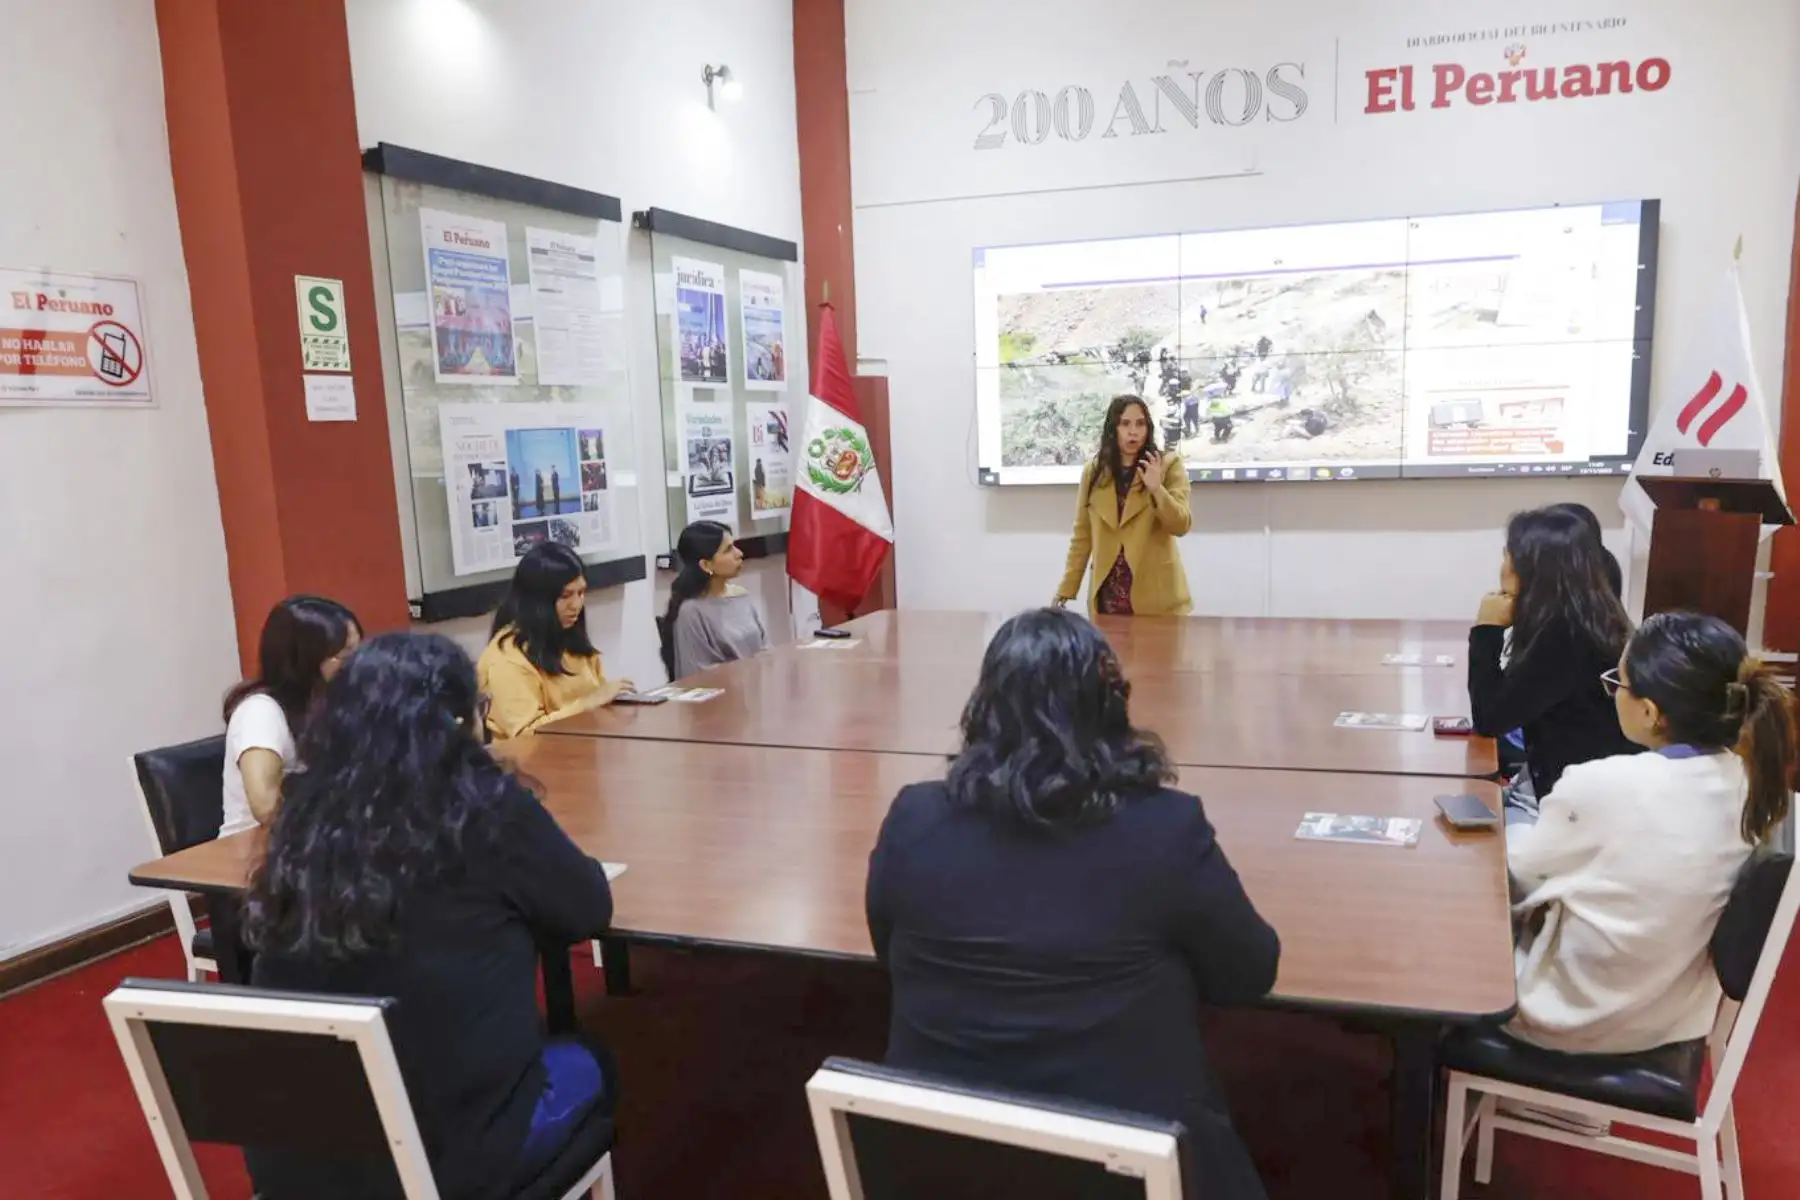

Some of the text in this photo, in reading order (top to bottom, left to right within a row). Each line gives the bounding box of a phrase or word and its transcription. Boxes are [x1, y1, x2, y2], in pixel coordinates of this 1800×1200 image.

[1406, 33, 1450, 48] DIARIO
[1364, 57, 1671, 114] El Peruano
[973, 59, 1309, 150] 200 AÑOS
[11, 290, 113, 316] El Peruano
[308, 286, 338, 332] S
[2, 338, 75, 352] NO HABLAR
[24, 353, 86, 368] TELÉFONO
